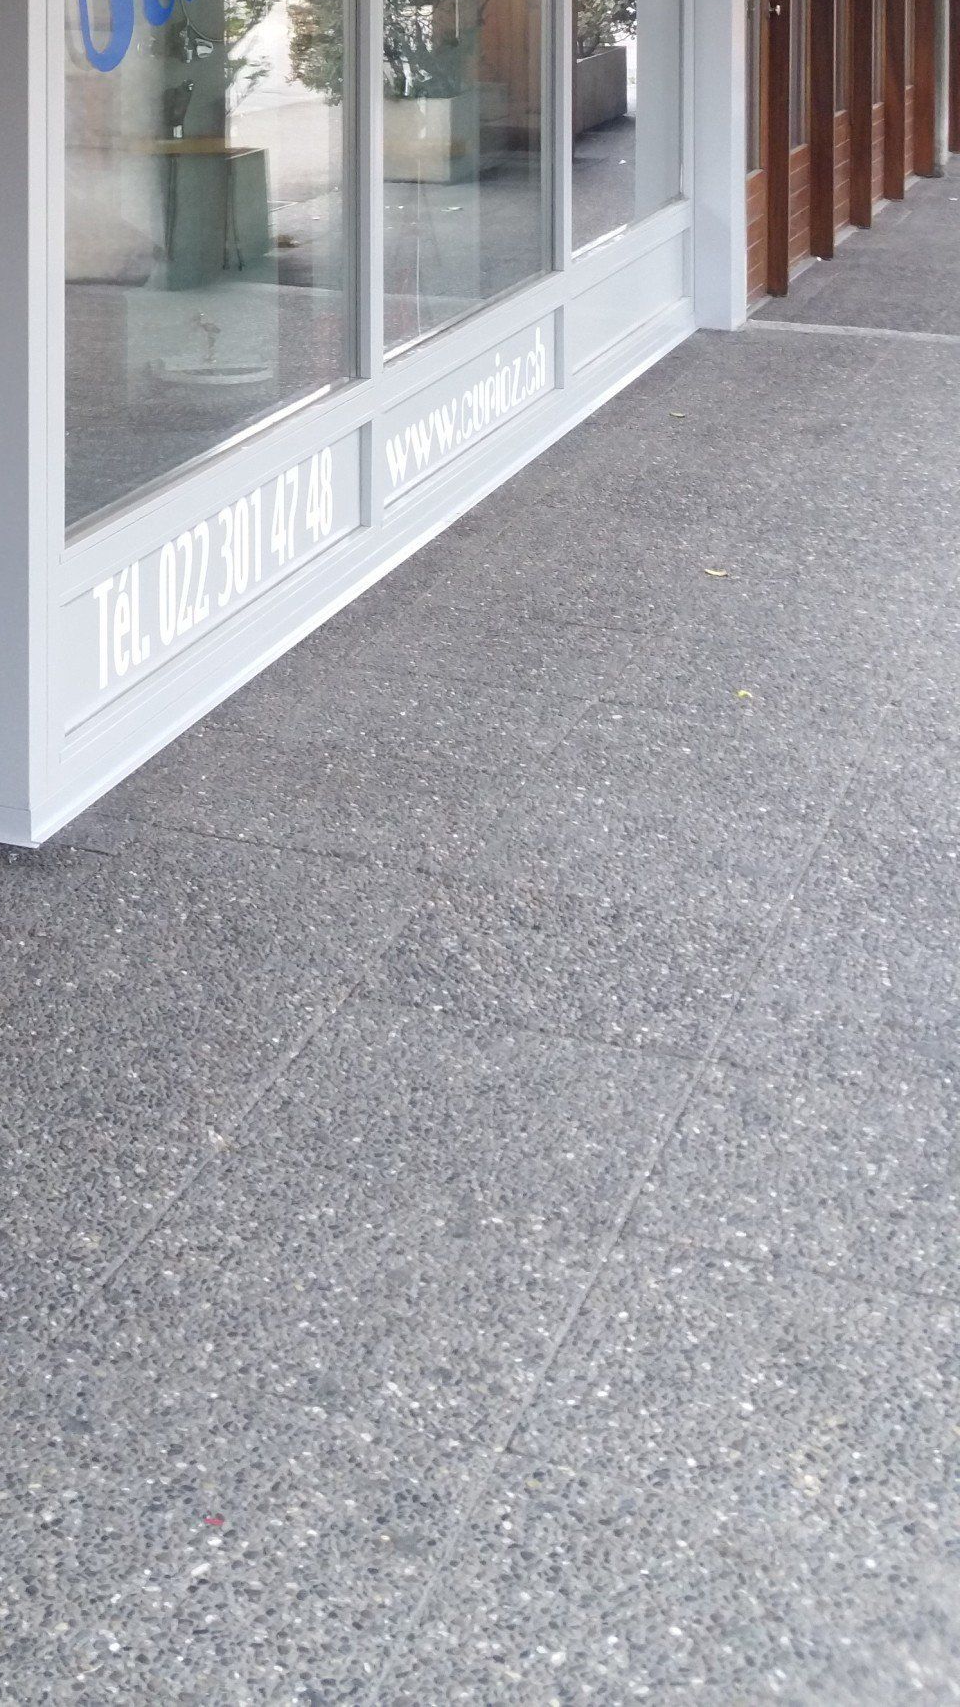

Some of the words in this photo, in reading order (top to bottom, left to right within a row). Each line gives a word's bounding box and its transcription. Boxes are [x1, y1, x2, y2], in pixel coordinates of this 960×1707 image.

[93, 561, 150, 690] Tél.
[159, 520, 210, 646] 022
[217, 486, 262, 608] 301
[270, 463, 299, 567] 47
[306, 446, 333, 544] 48
